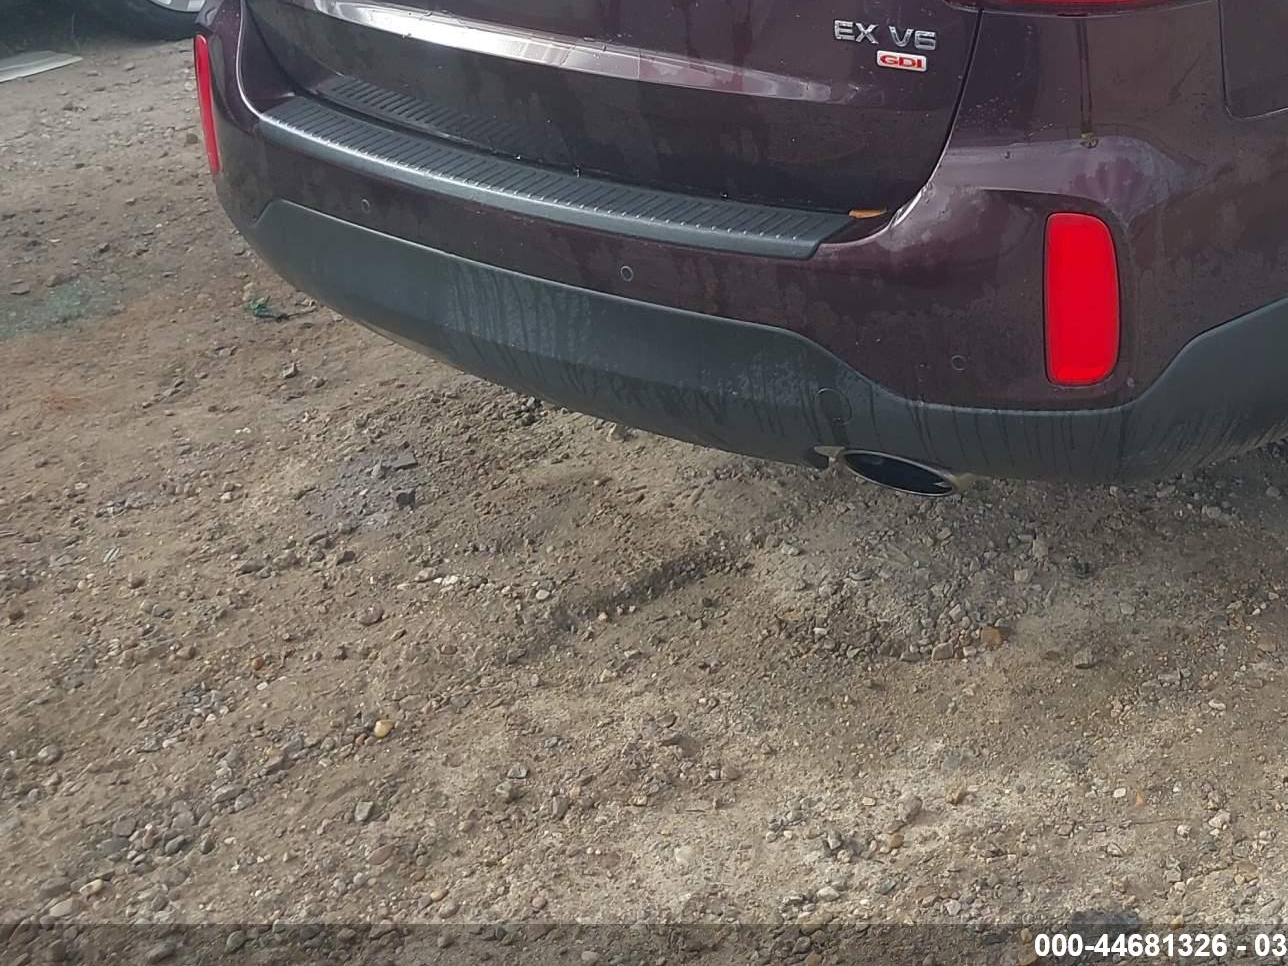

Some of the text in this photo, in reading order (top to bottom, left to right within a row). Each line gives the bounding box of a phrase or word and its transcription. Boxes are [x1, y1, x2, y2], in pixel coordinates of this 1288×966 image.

[834, 20, 937, 50] EX V6
[879, 54, 924, 69] GDI
